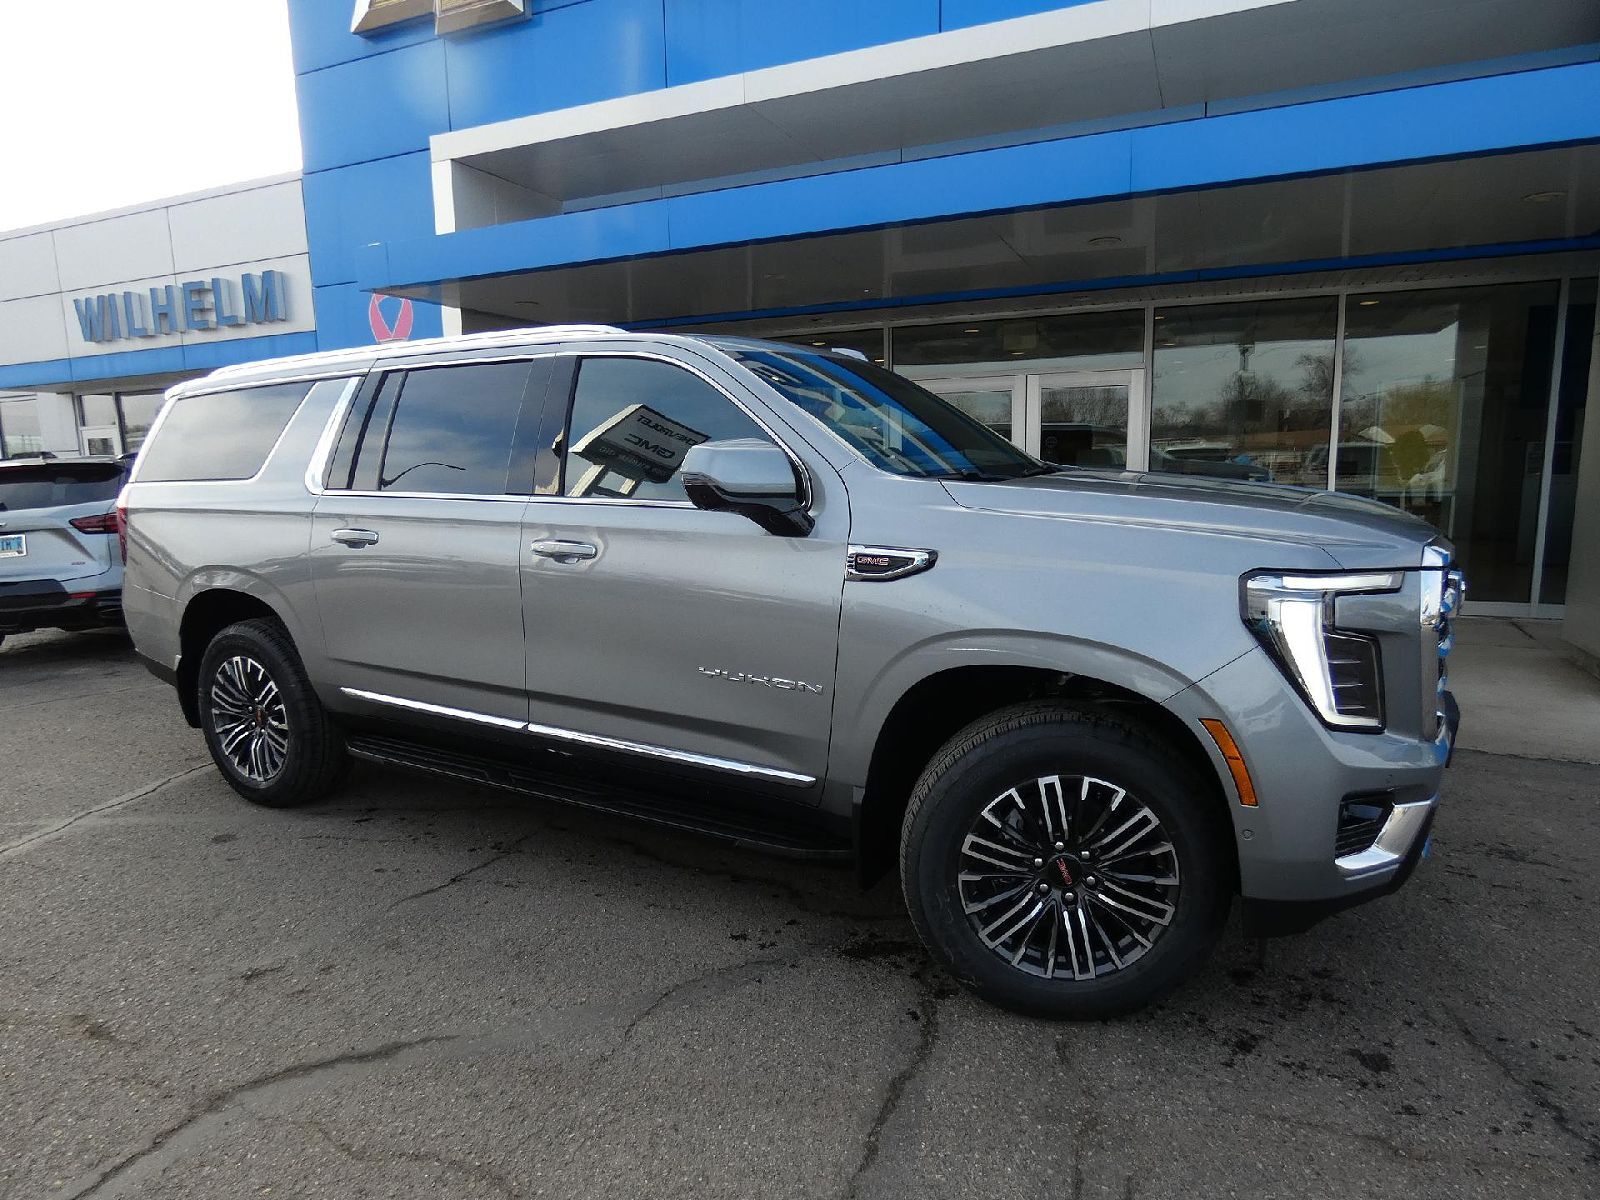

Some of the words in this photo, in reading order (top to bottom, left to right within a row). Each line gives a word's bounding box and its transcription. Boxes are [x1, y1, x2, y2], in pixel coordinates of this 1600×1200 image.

[73, 269, 286, 343] WILHELM
[857, 556, 889, 566] GMC
[698, 666, 823, 695] YUKON
